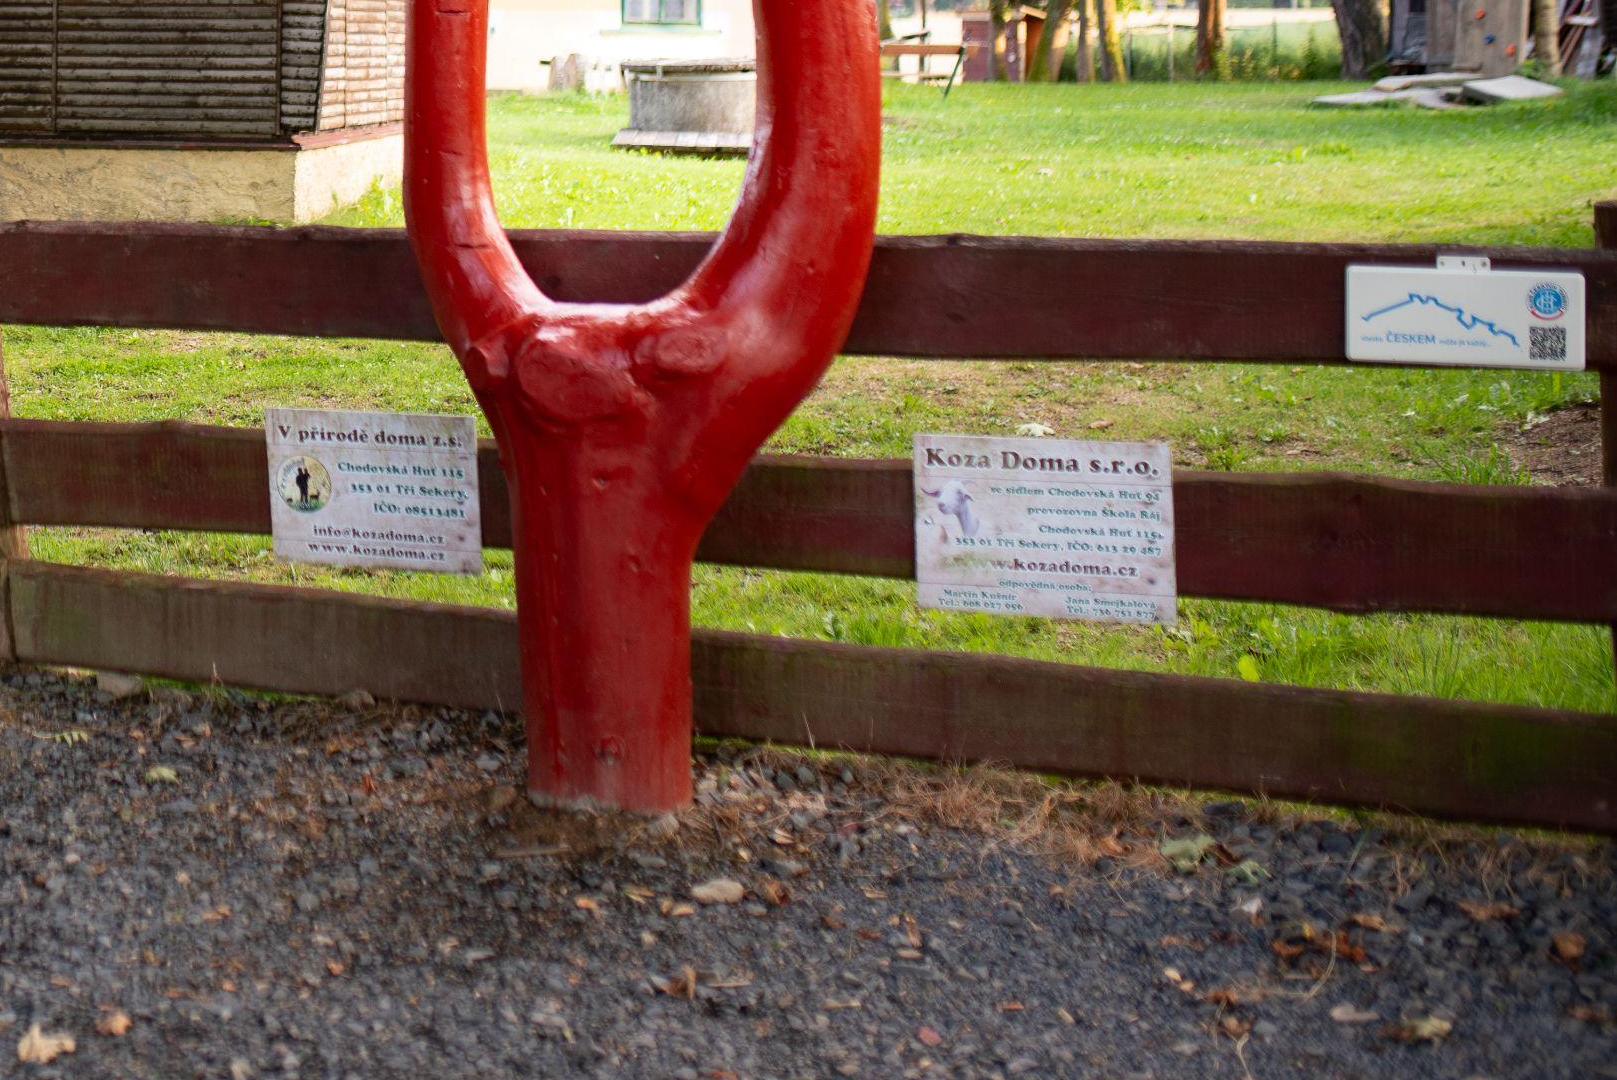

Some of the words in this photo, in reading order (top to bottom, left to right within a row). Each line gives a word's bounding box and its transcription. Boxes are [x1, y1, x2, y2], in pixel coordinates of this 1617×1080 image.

[1386, 330, 1436, 345] ČESKEM
[278, 425, 292, 440] V
[298, 426, 369, 443] přírodě
[375, 430, 426, 446] doma
[926, 448, 991, 469] Koza
[1001, 451, 1080, 473] Doma
[1090, 458, 1160, 476] s.r.o.
[337, 461, 408, 475] Chodovská
[442, 468, 465, 479] 115
[351, 483, 372, 494] 353
[376, 484, 390, 494] 01
[990, 486, 1002, 494] se
[1048, 486, 1115, 499] Chodovská
[1027, 506, 1098, 517] provozovna
[1102, 505, 1137, 519] Škola
[312, 524, 445, 544] info@kozadoma.cz
[1038, 524, 1106, 537] Chodovská
[955, 536, 976, 546] 353
[307, 543, 446, 561] www.kozadoma.cz
[1065, 596, 1091, 605] Jana
